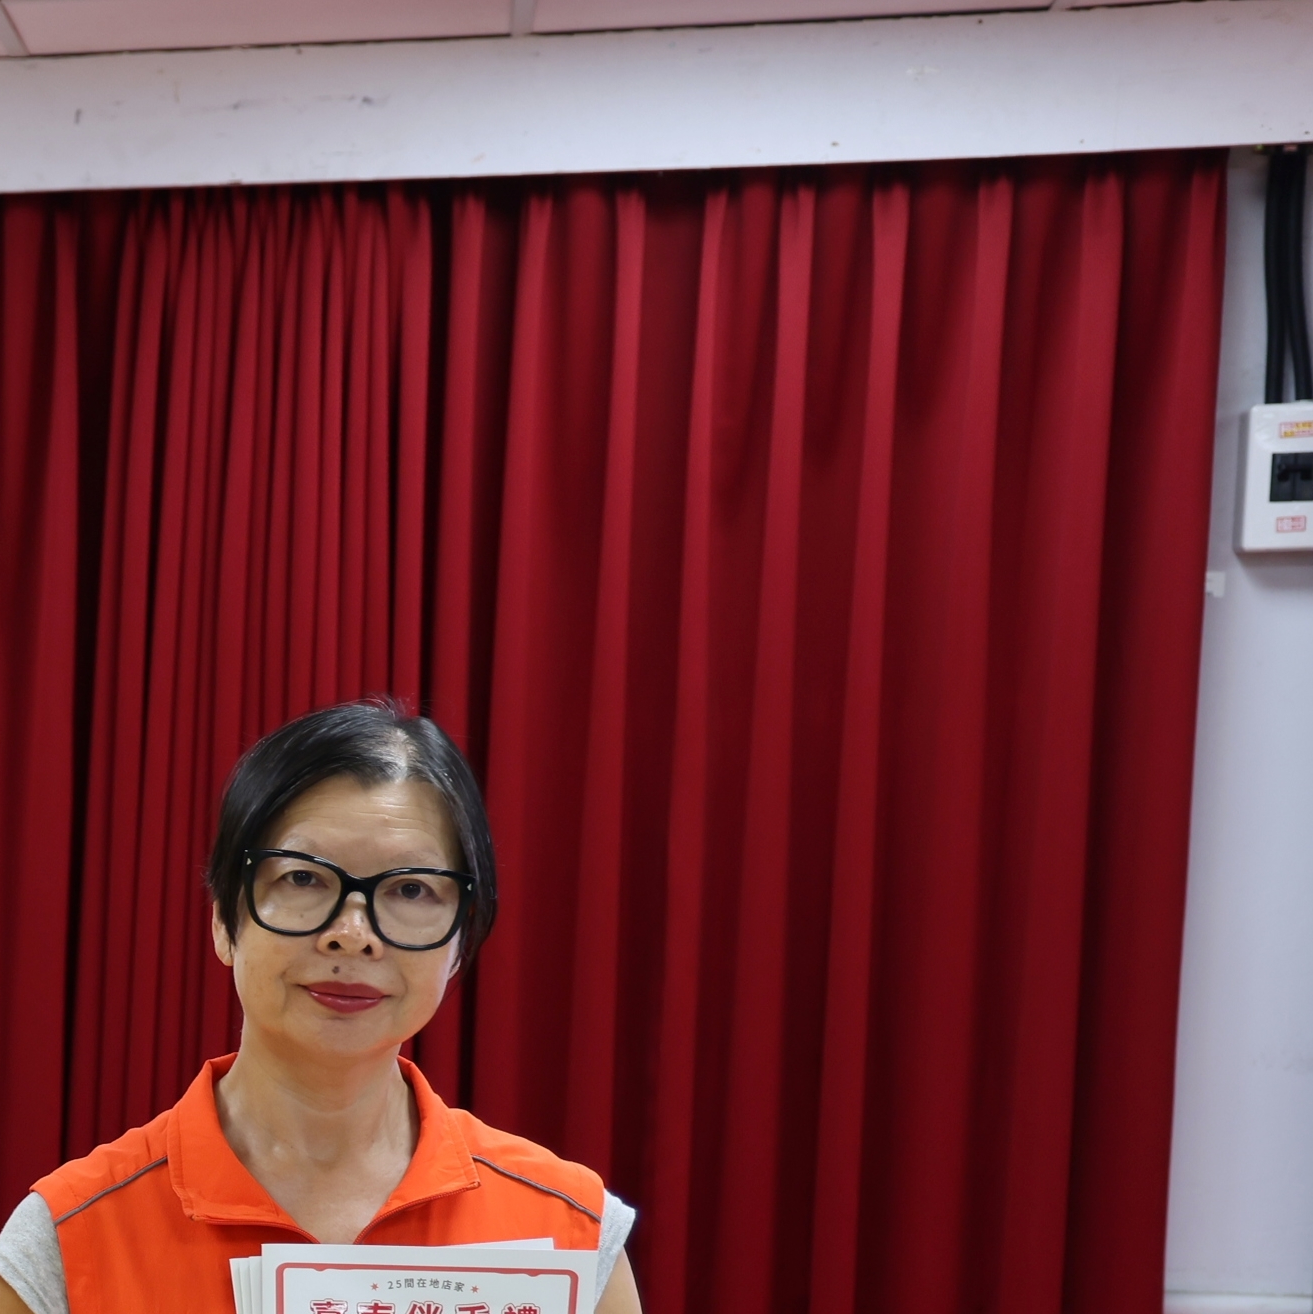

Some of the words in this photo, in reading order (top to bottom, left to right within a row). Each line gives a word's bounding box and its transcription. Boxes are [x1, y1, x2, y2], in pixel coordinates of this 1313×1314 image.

[386, 1277, 466, 1294] 25間在地店家
